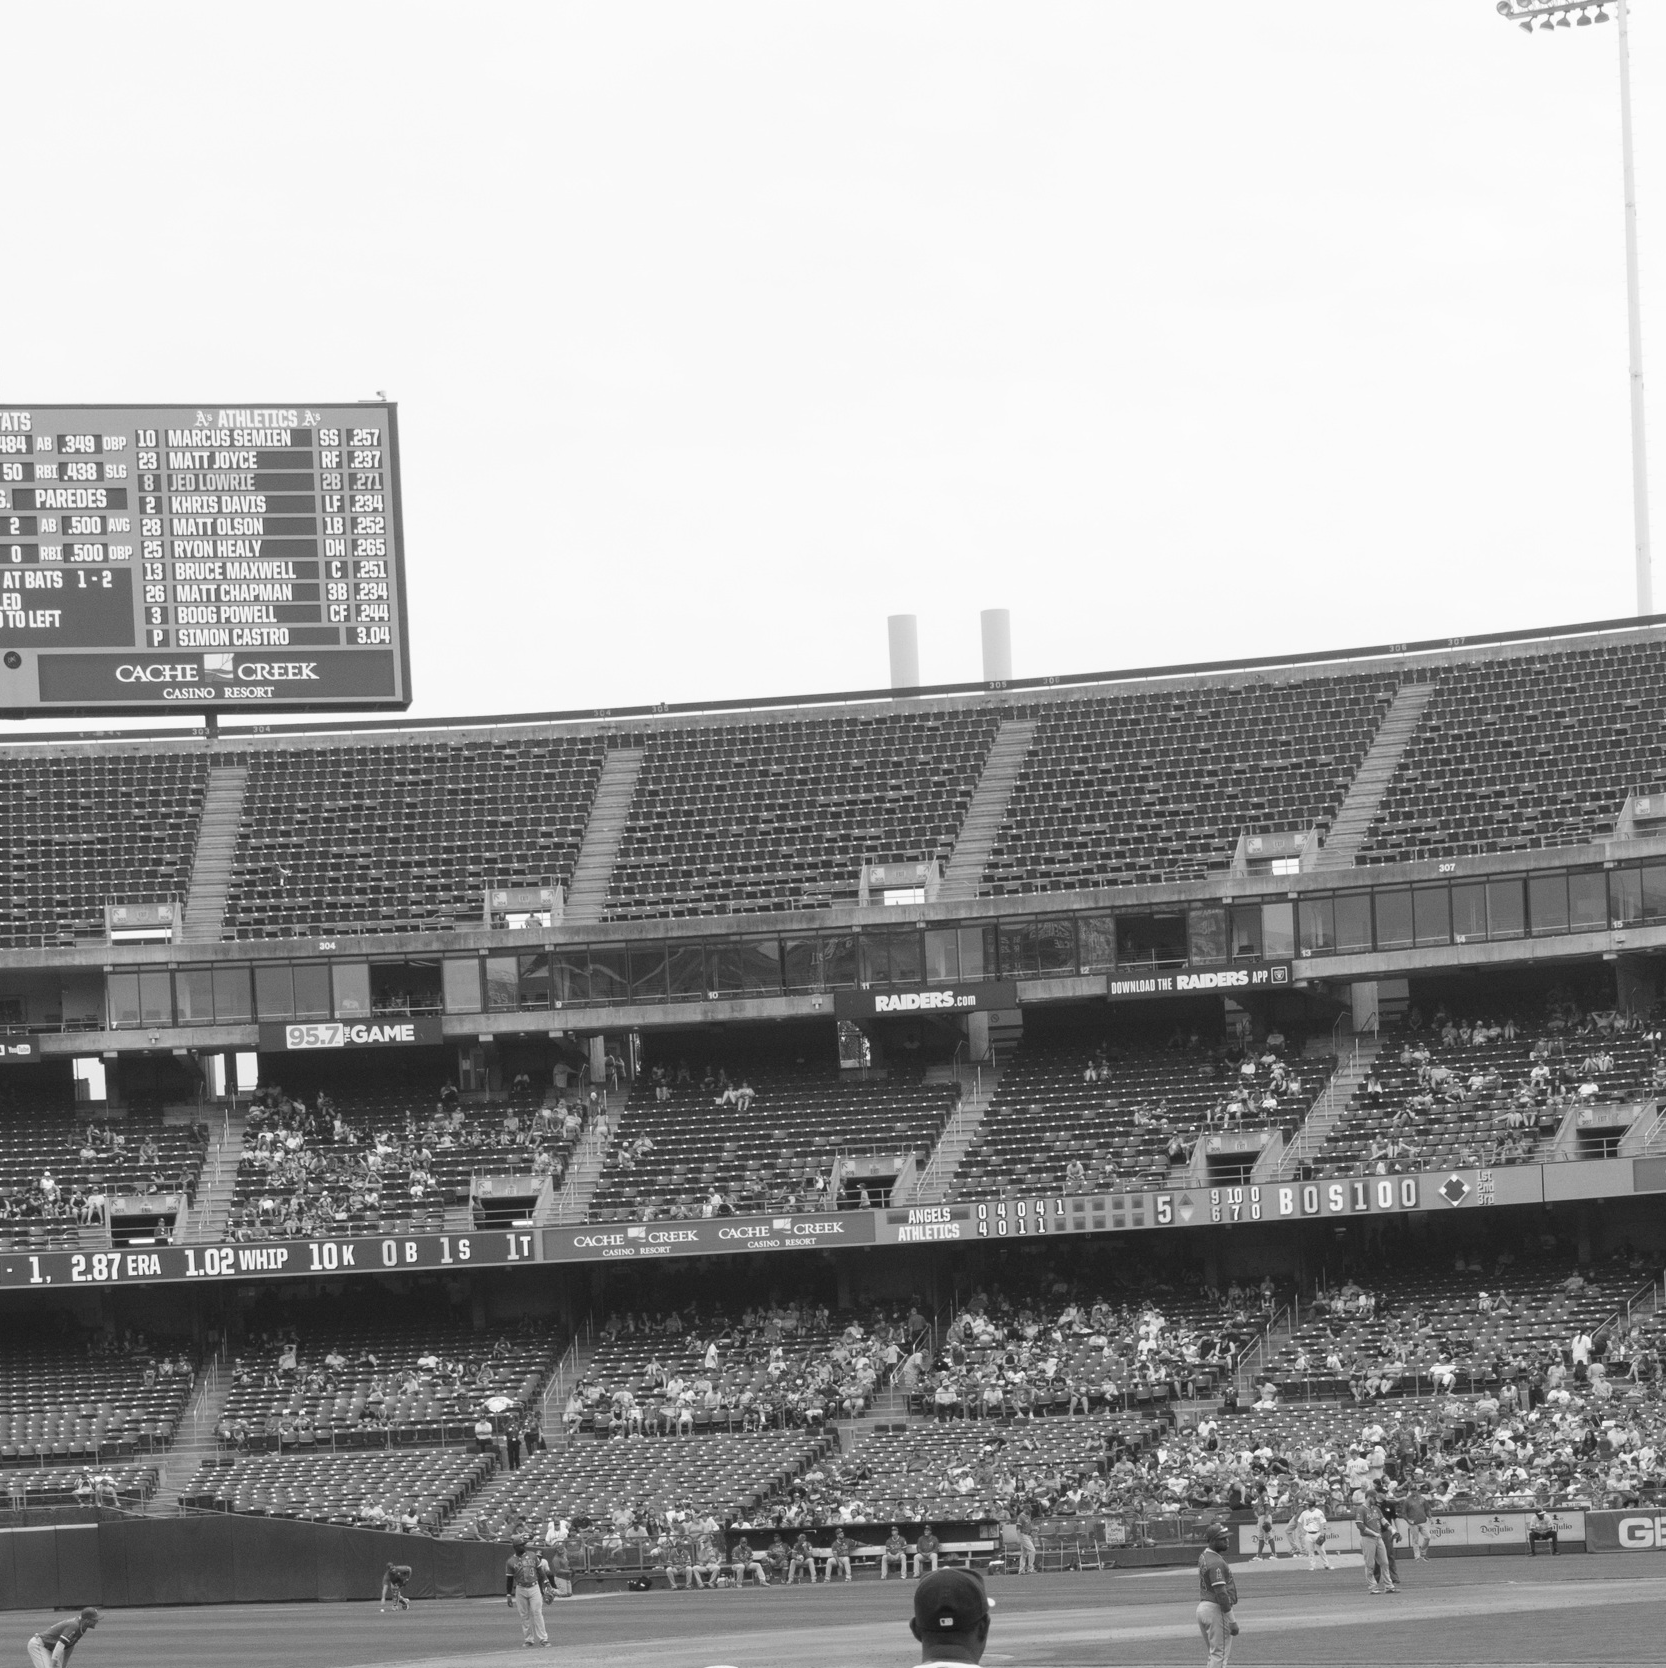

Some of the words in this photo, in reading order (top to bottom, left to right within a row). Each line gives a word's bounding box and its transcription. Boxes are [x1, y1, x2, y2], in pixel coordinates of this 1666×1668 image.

[218, 410, 298, 427] ATHLETICS
[168, 429, 230, 447] MARCUS
[234, 429, 291, 446] SEMIEN
[169, 451, 210, 469] MATT
[213, 451, 257, 468] JOYCE
[170, 474, 196, 492] JED
[199, 474, 256, 492] LOWRIE
[35, 489, 107, 508] PAREDES
[172, 496, 218, 513] KHRIS
[221, 495, 266, 513] DAVIS
[173, 518, 214, 535] MATT
[217, 518, 263, 535] OLSON
[174, 540, 213, 558] RYON
[217, 540, 261, 557] HEALY
[175, 562, 223, 580] BRUCE
[226, 561, 296, 579] MAXWELL
[3, 571, 22, 589] AT
[25, 571, 63, 588] BATS
[176, 584, 217, 602] MATT
[220, 584, 292, 601] CHAPMAN
[6, 610, 26, 628] TO
[29, 610, 61, 628] LEFT
[178, 606, 217, 623] BOOG
[220, 606, 277, 623] POWELL
[179, 628, 229, 646] SIMON
[233, 627, 289, 645] CASTRO
[116, 664, 199, 682] CACHE
[238, 663, 320, 680] CREEK
[163, 687, 215, 702] CASINO
[224, 687, 274, 698] RESORT
[1439, 863, 1455, 872] 307
[319, 942, 336, 950] 304
[1111, 979, 1155, 994] DOWNLOAD
[1157, 978, 1172, 990] THE
[1176, 970, 1249, 990] RAIDERS
[1252, 970, 1268, 983] APP
[875, 991, 976, 1012] RAIDERS.com
[289, 1025, 340, 1047] 95.7
[350, 1024, 415, 1043] GAME
[71, 1253, 121, 1281] 2.87
[127, 1254, 161, 1276] ERA
[185, 1248, 235, 1276] 1.02
[238, 1248, 288, 1270] WHIP
[309, 1243, 338, 1270] 10
